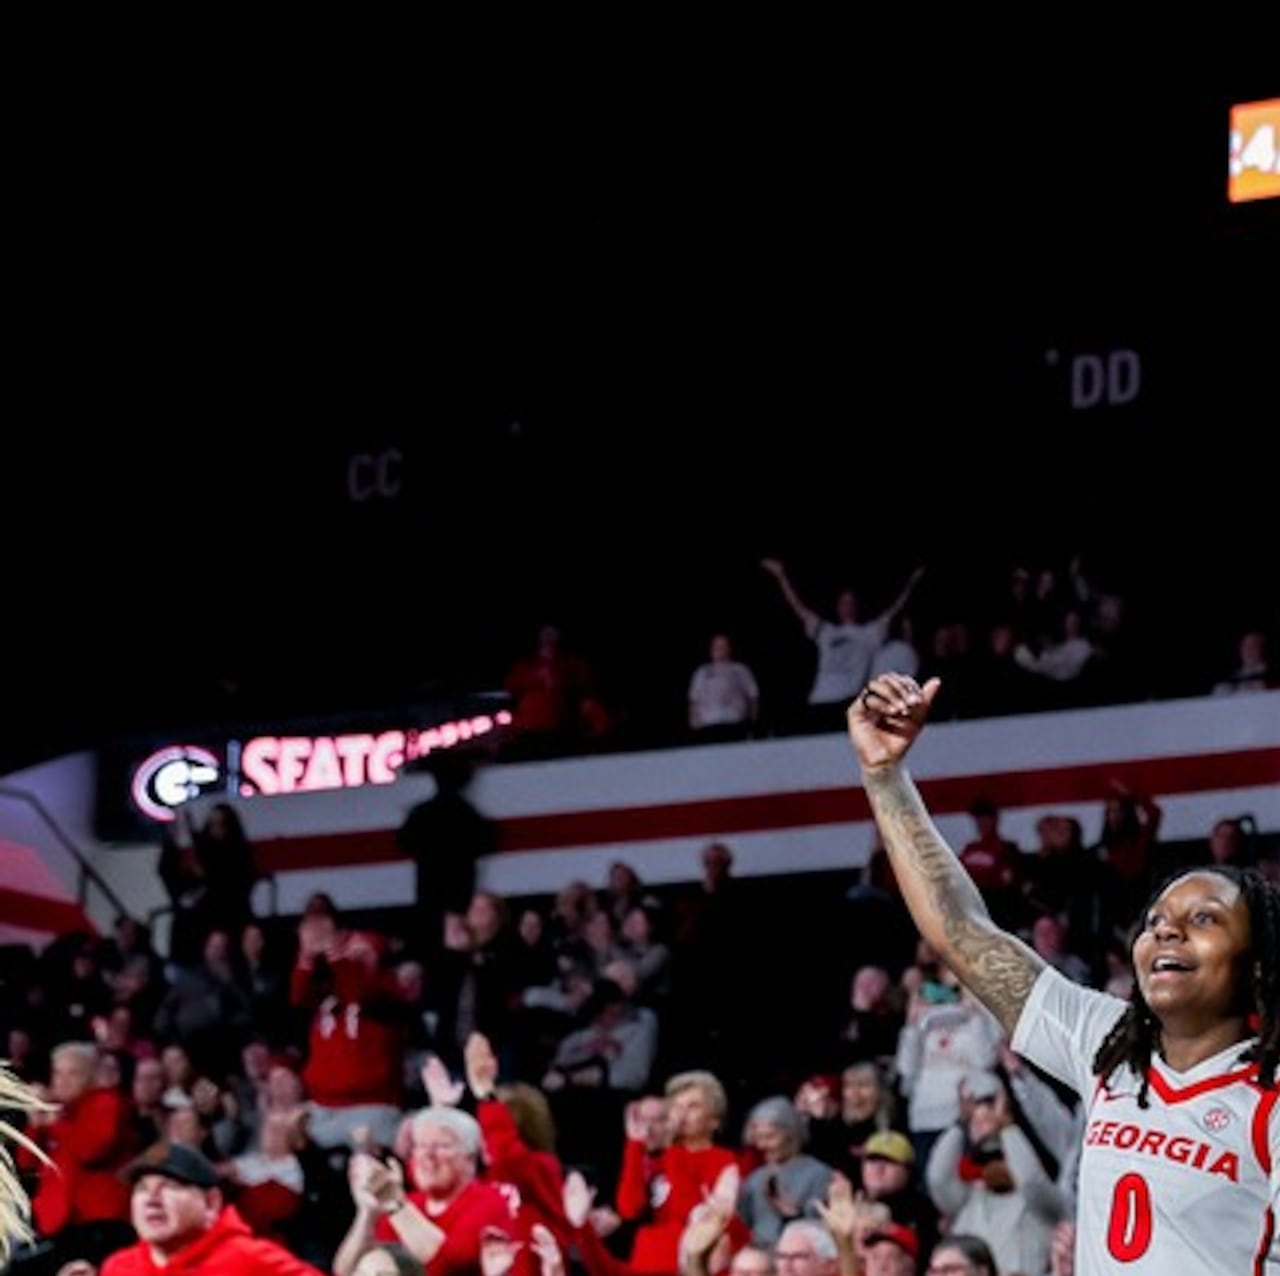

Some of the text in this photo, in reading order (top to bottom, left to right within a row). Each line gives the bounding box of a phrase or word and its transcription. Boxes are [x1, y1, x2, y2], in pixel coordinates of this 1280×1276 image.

[1070, 348, 1142, 411] DD
[346, 447, 405, 504] CC
[1086, 1120, 1240, 1184] GEORGIA
[1107, 1172, 1153, 1263] 0
